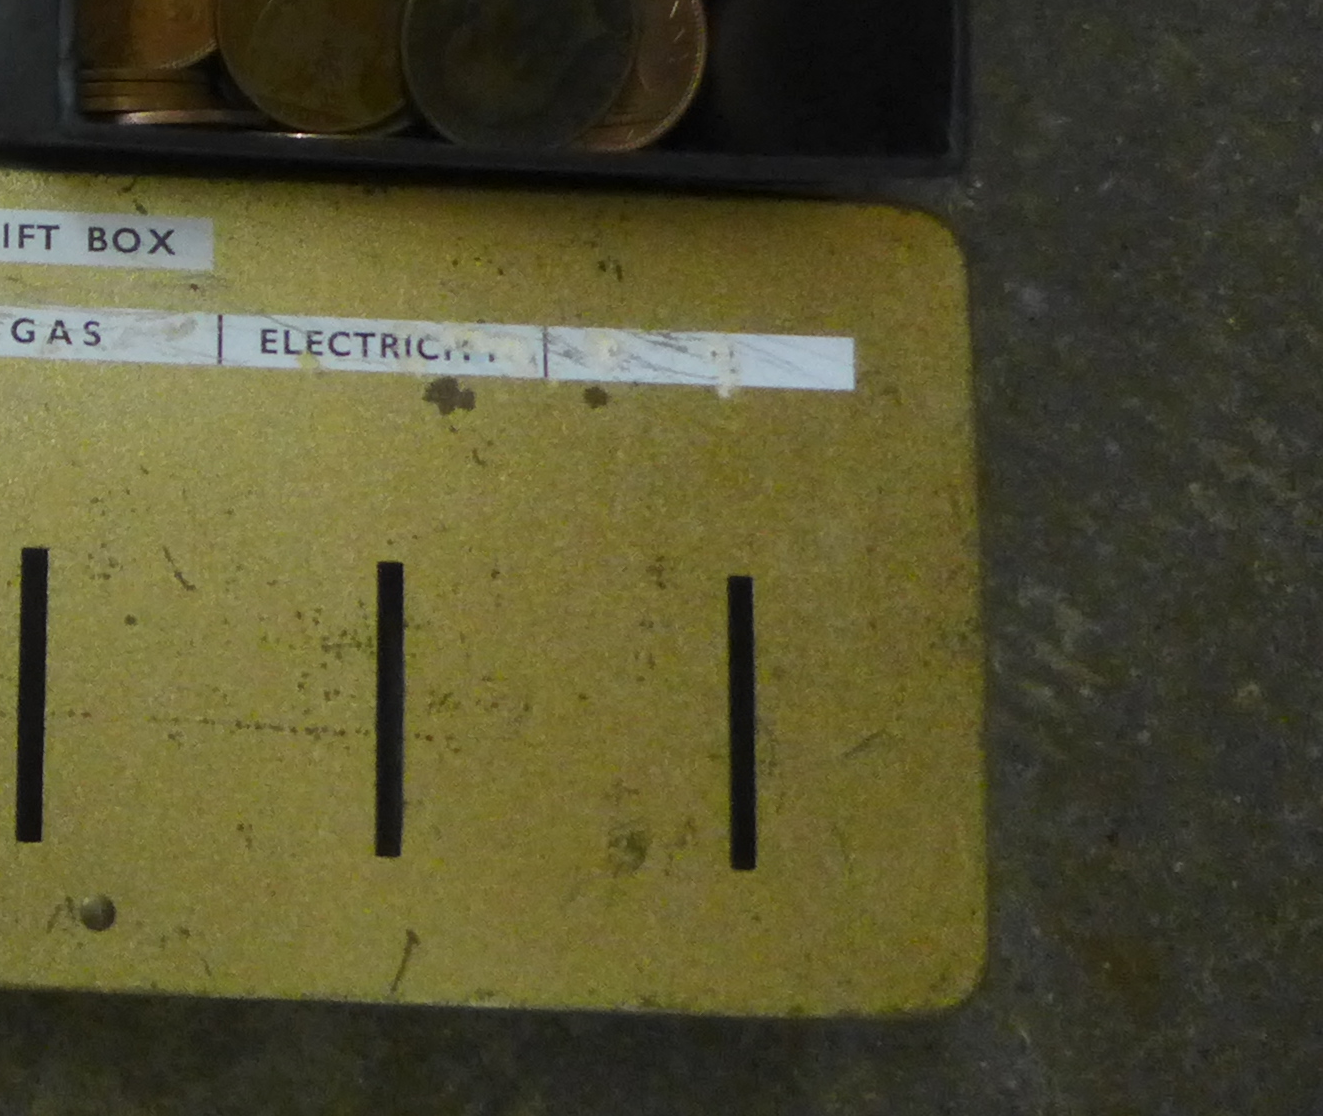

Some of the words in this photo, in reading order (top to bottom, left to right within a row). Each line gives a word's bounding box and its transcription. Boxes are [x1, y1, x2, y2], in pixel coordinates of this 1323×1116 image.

[87, 224, 177, 256] BOX
[10, 317, 103, 349] GAS
[261, 328, 496, 364] ELECTRIC
